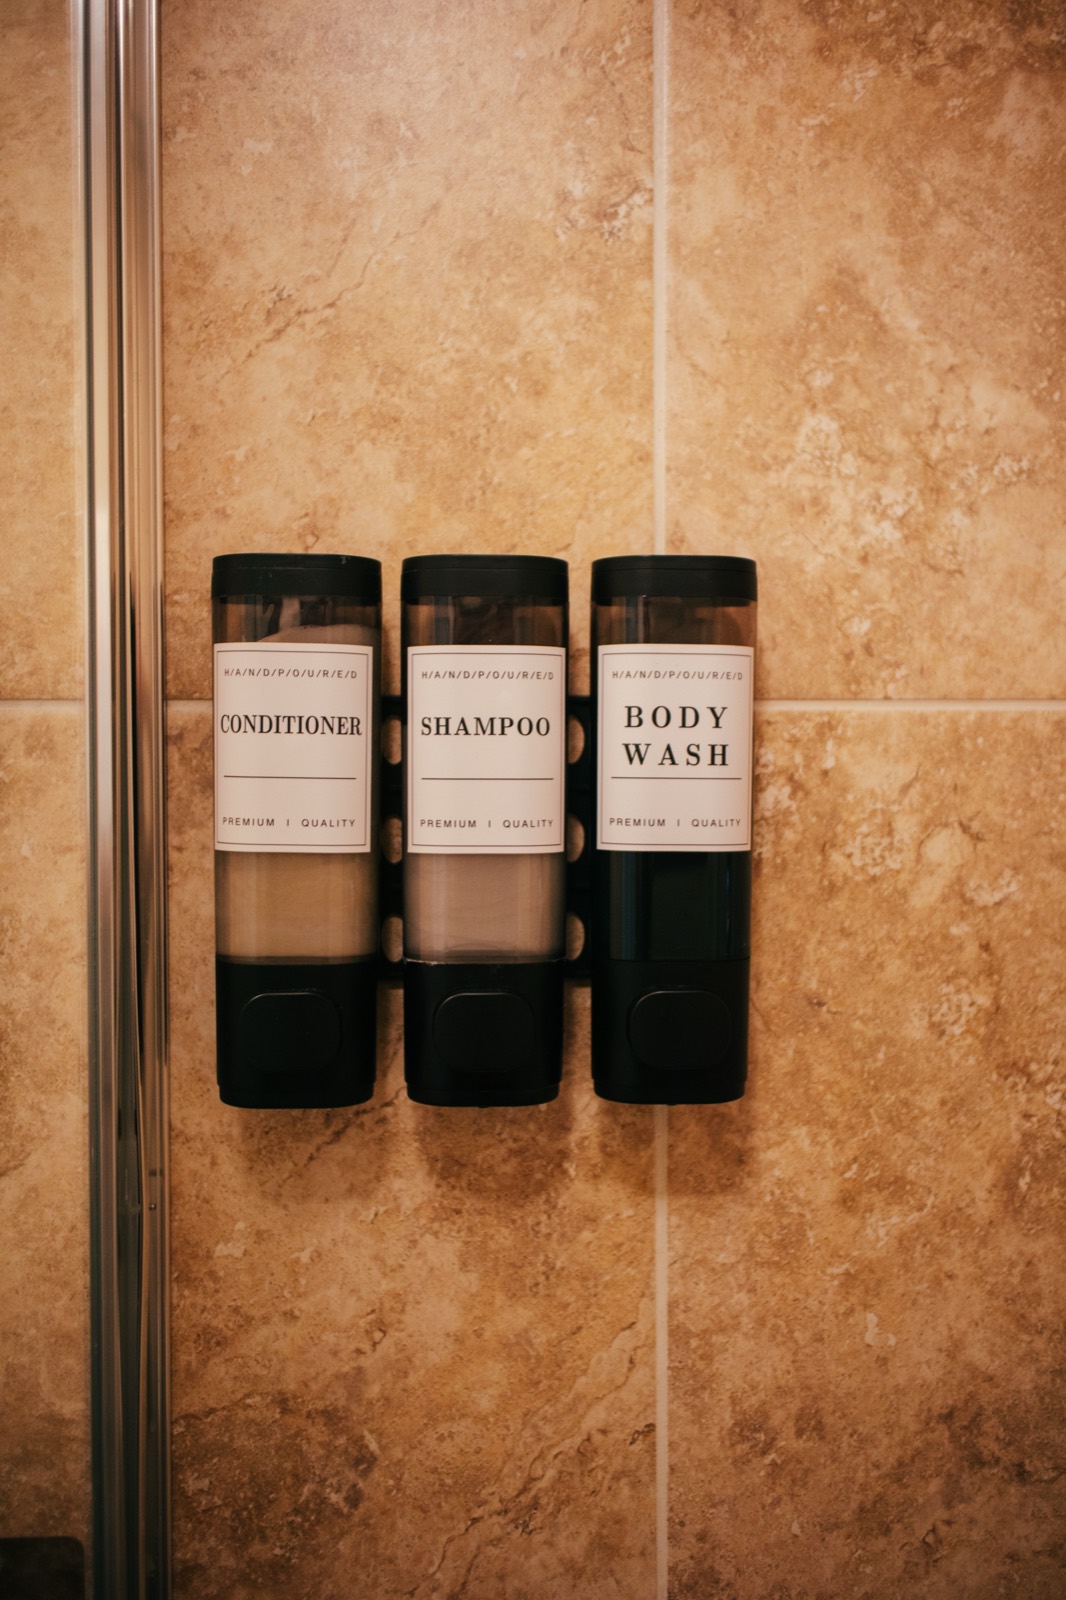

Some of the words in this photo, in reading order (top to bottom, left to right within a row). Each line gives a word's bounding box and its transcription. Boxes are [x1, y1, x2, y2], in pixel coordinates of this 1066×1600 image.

[224, 668, 358, 679] H/A/N/D/P/O/U/R/E/D
[421, 670, 554, 680] H/A/N/D/P/O/U/R/E/D
[612, 670, 743, 680] H/A/N/D/P/O/U/R/E/D
[624, 705, 728, 729] BODY
[220, 714, 362, 735] CONDITIONER
[421, 716, 551, 736] SHAMPOO
[622, 743, 729, 766] WASH
[222, 816, 275, 827] PREMIUM
[301, 818, 356, 828] QUALITY
[420, 819, 477, 828] PREMIUM
[502, 819, 554, 828] QUALITY
[609, 817, 666, 827] PREMIUM
[691, 818, 741, 827] QUALITY
